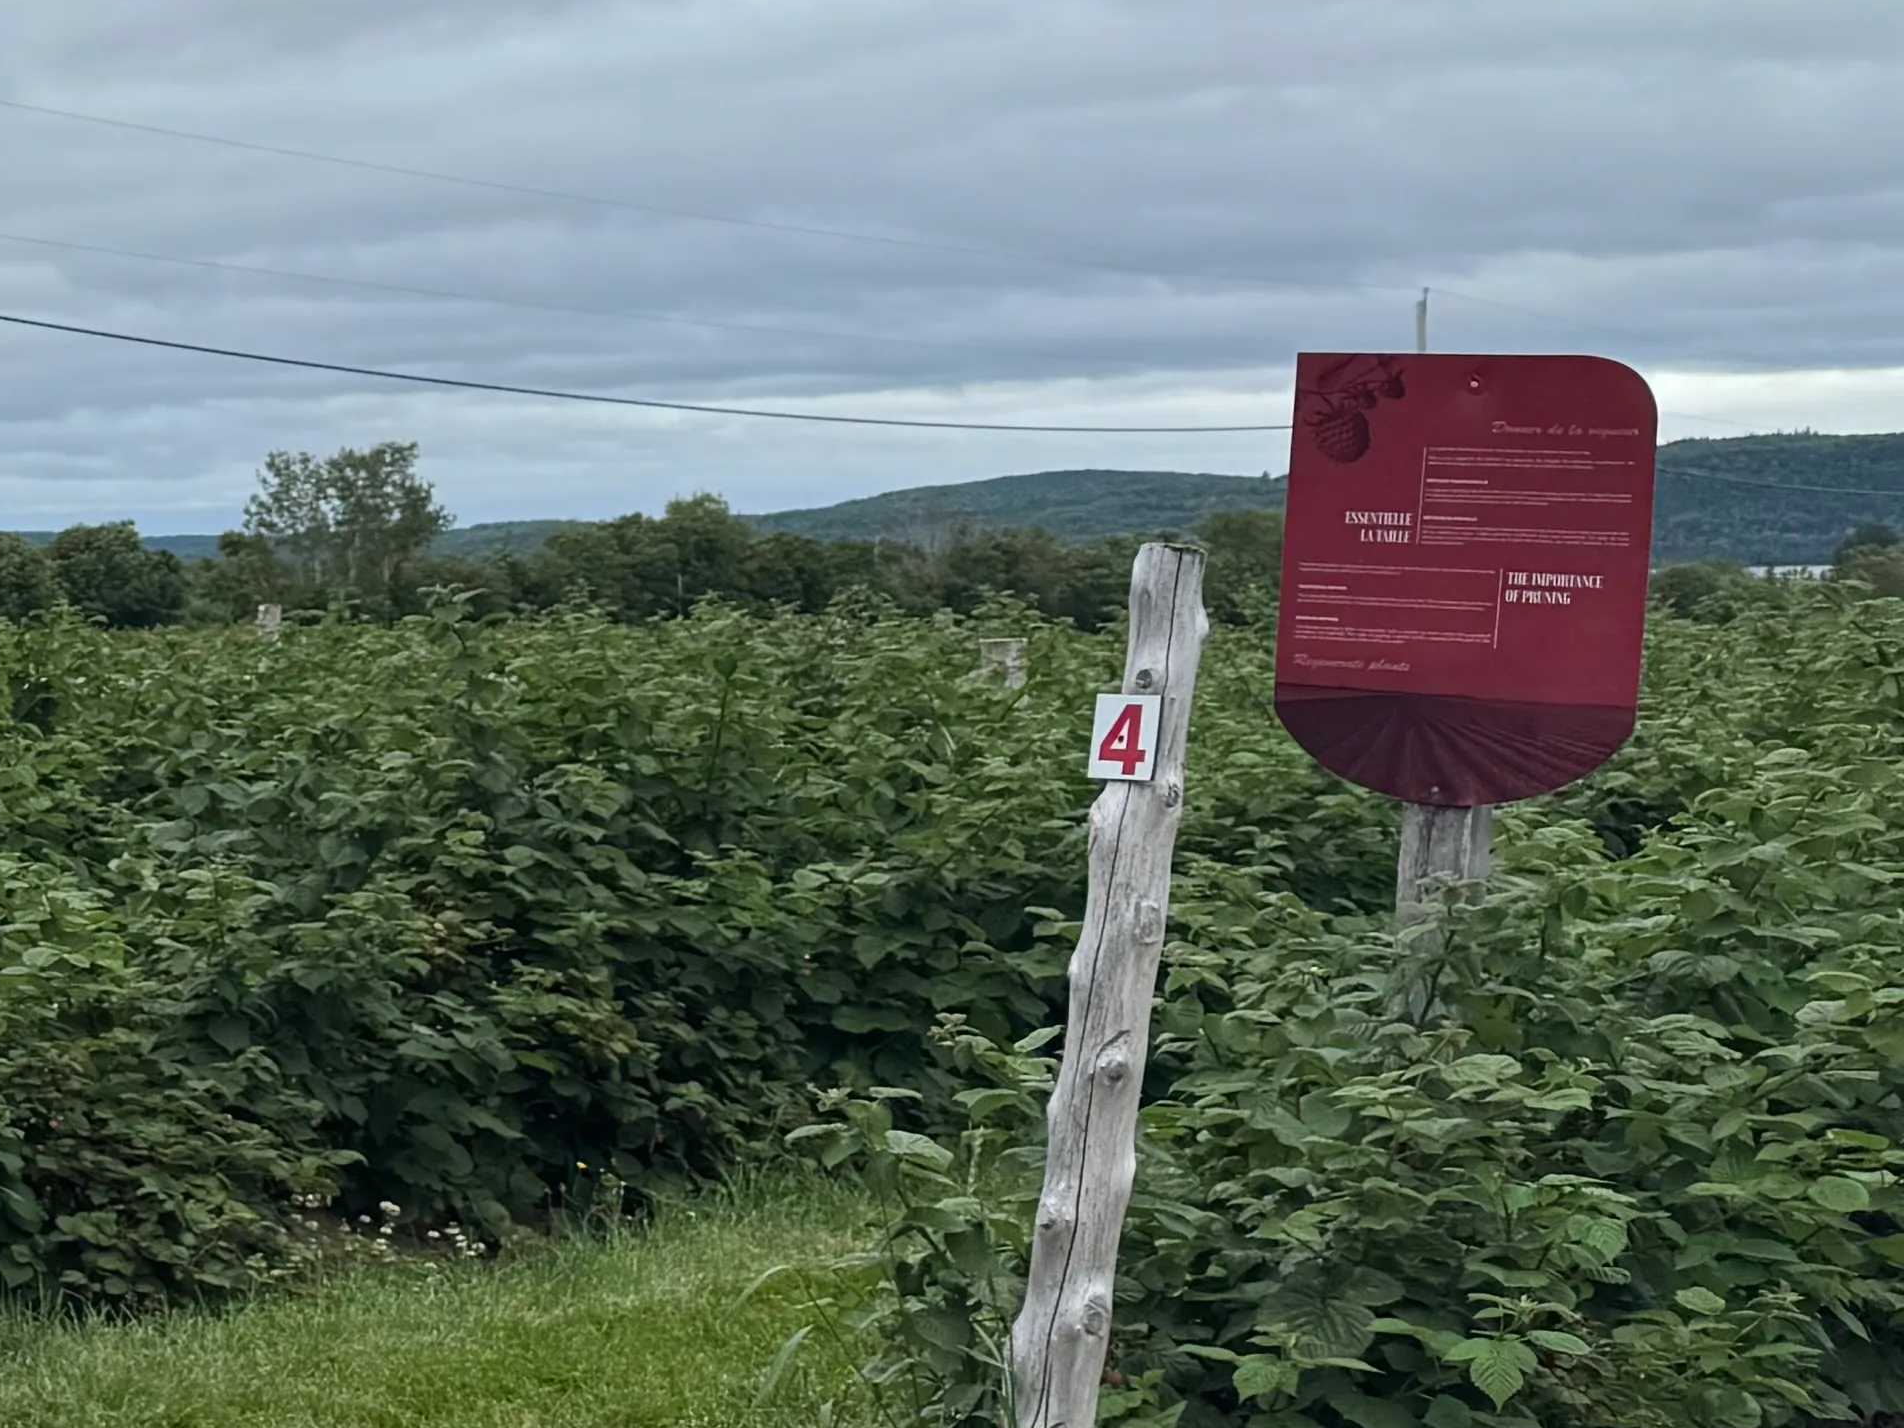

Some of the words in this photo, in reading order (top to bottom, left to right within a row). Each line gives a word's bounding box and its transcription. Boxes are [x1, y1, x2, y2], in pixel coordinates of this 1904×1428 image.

[1506, 571, 1529, 586] THE
[1531, 572, 1604, 589] IMPORTANCE
[1505, 589, 1520, 603] OF
[1521, 590, 1571, 605] PRUNING
[1098, 703, 1147, 776] 4
